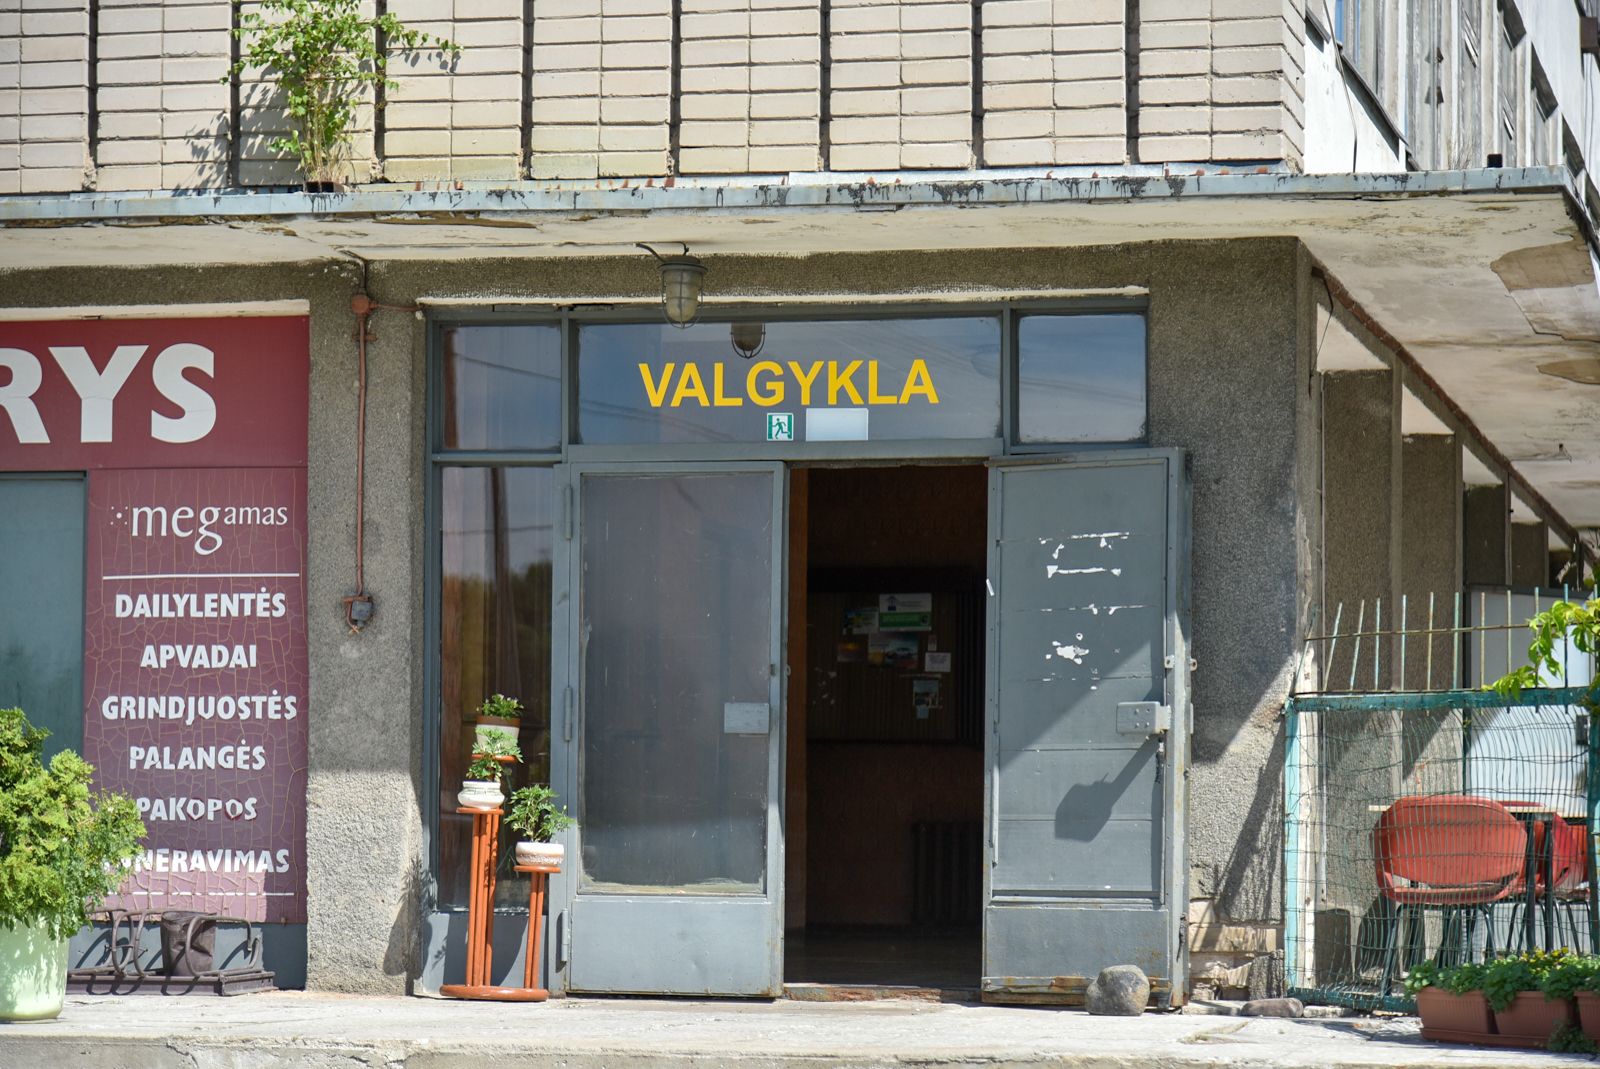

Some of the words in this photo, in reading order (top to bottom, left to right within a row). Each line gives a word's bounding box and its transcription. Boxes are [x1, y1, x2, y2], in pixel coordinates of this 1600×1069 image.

[638, 359, 940, 407] VALGYKLA
[131, 505, 288, 555] megamas
[115, 586, 286, 618] DAILYLENTĖS
[140, 644, 257, 668] APVADAI
[102, 689, 297, 725] GRINDJUOSTĖS
[129, 739, 266, 770] PALANGĖS
[136, 797, 257, 821] PAKOPOS
